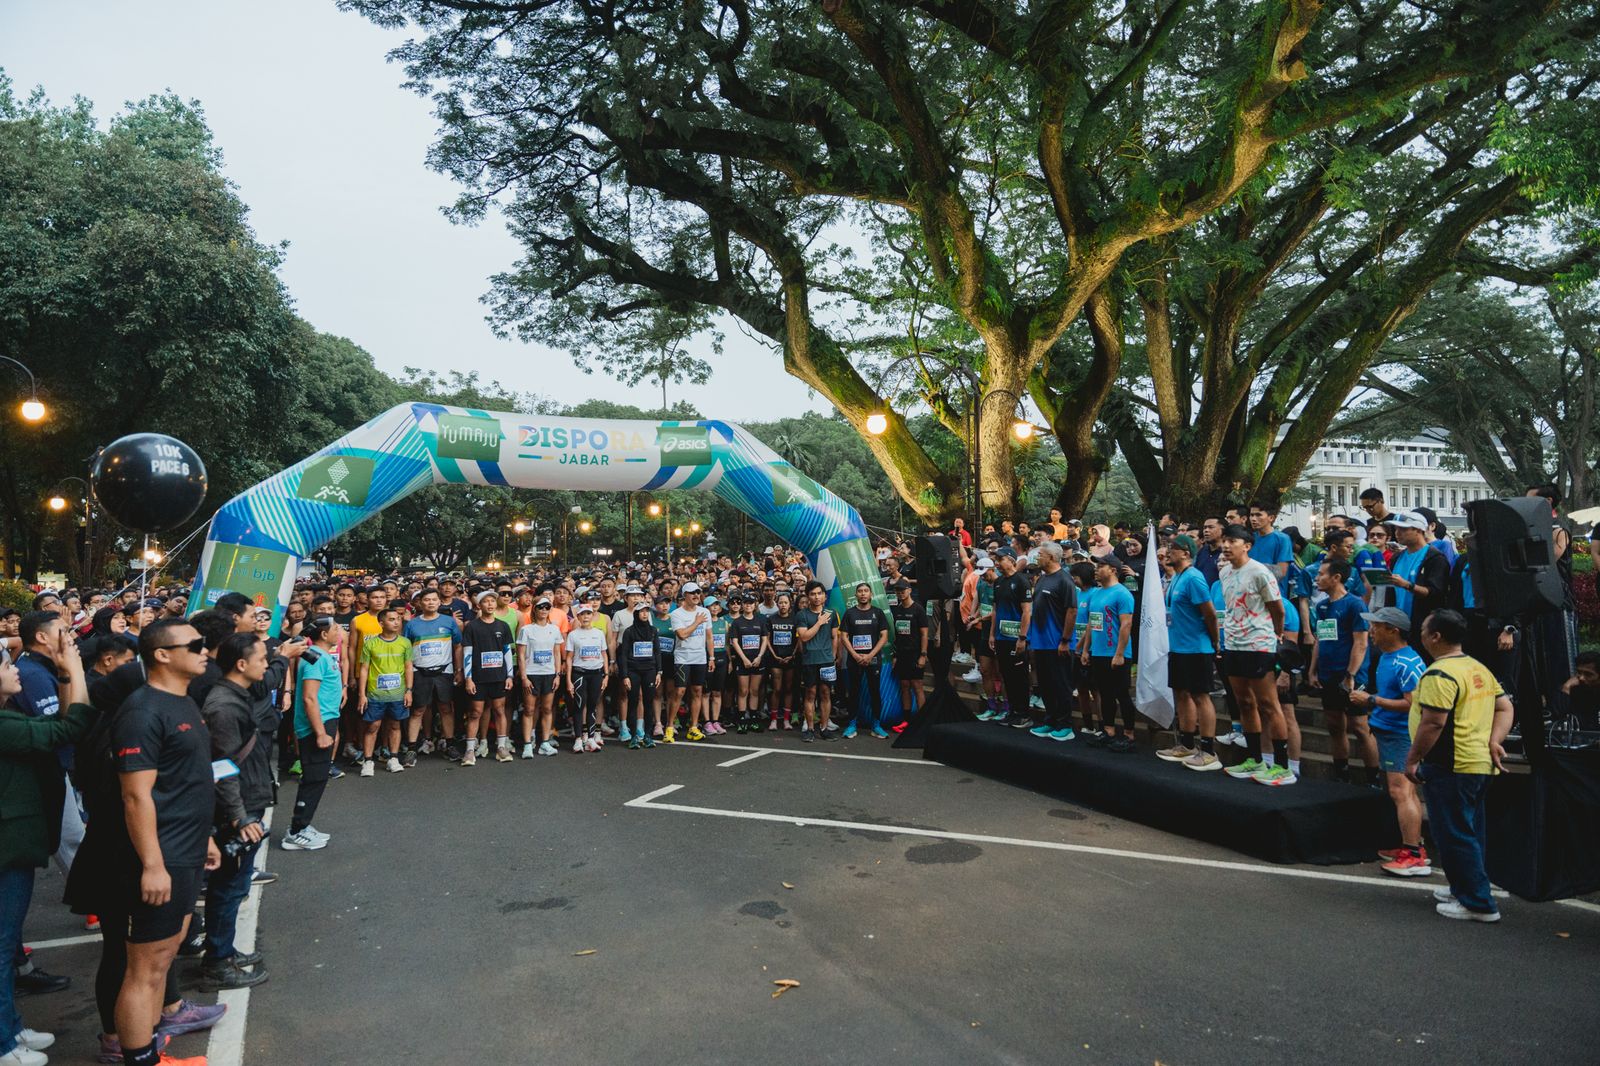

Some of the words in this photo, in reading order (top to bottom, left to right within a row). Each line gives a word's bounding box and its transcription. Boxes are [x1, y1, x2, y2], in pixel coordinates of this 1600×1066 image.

[518, 425, 645, 450] DISPORA
[155, 444, 183, 459] 10K
[559, 453, 609, 466] JABAR
[151, 460, 181, 474] PACE
[182, 462, 190, 475] 6
